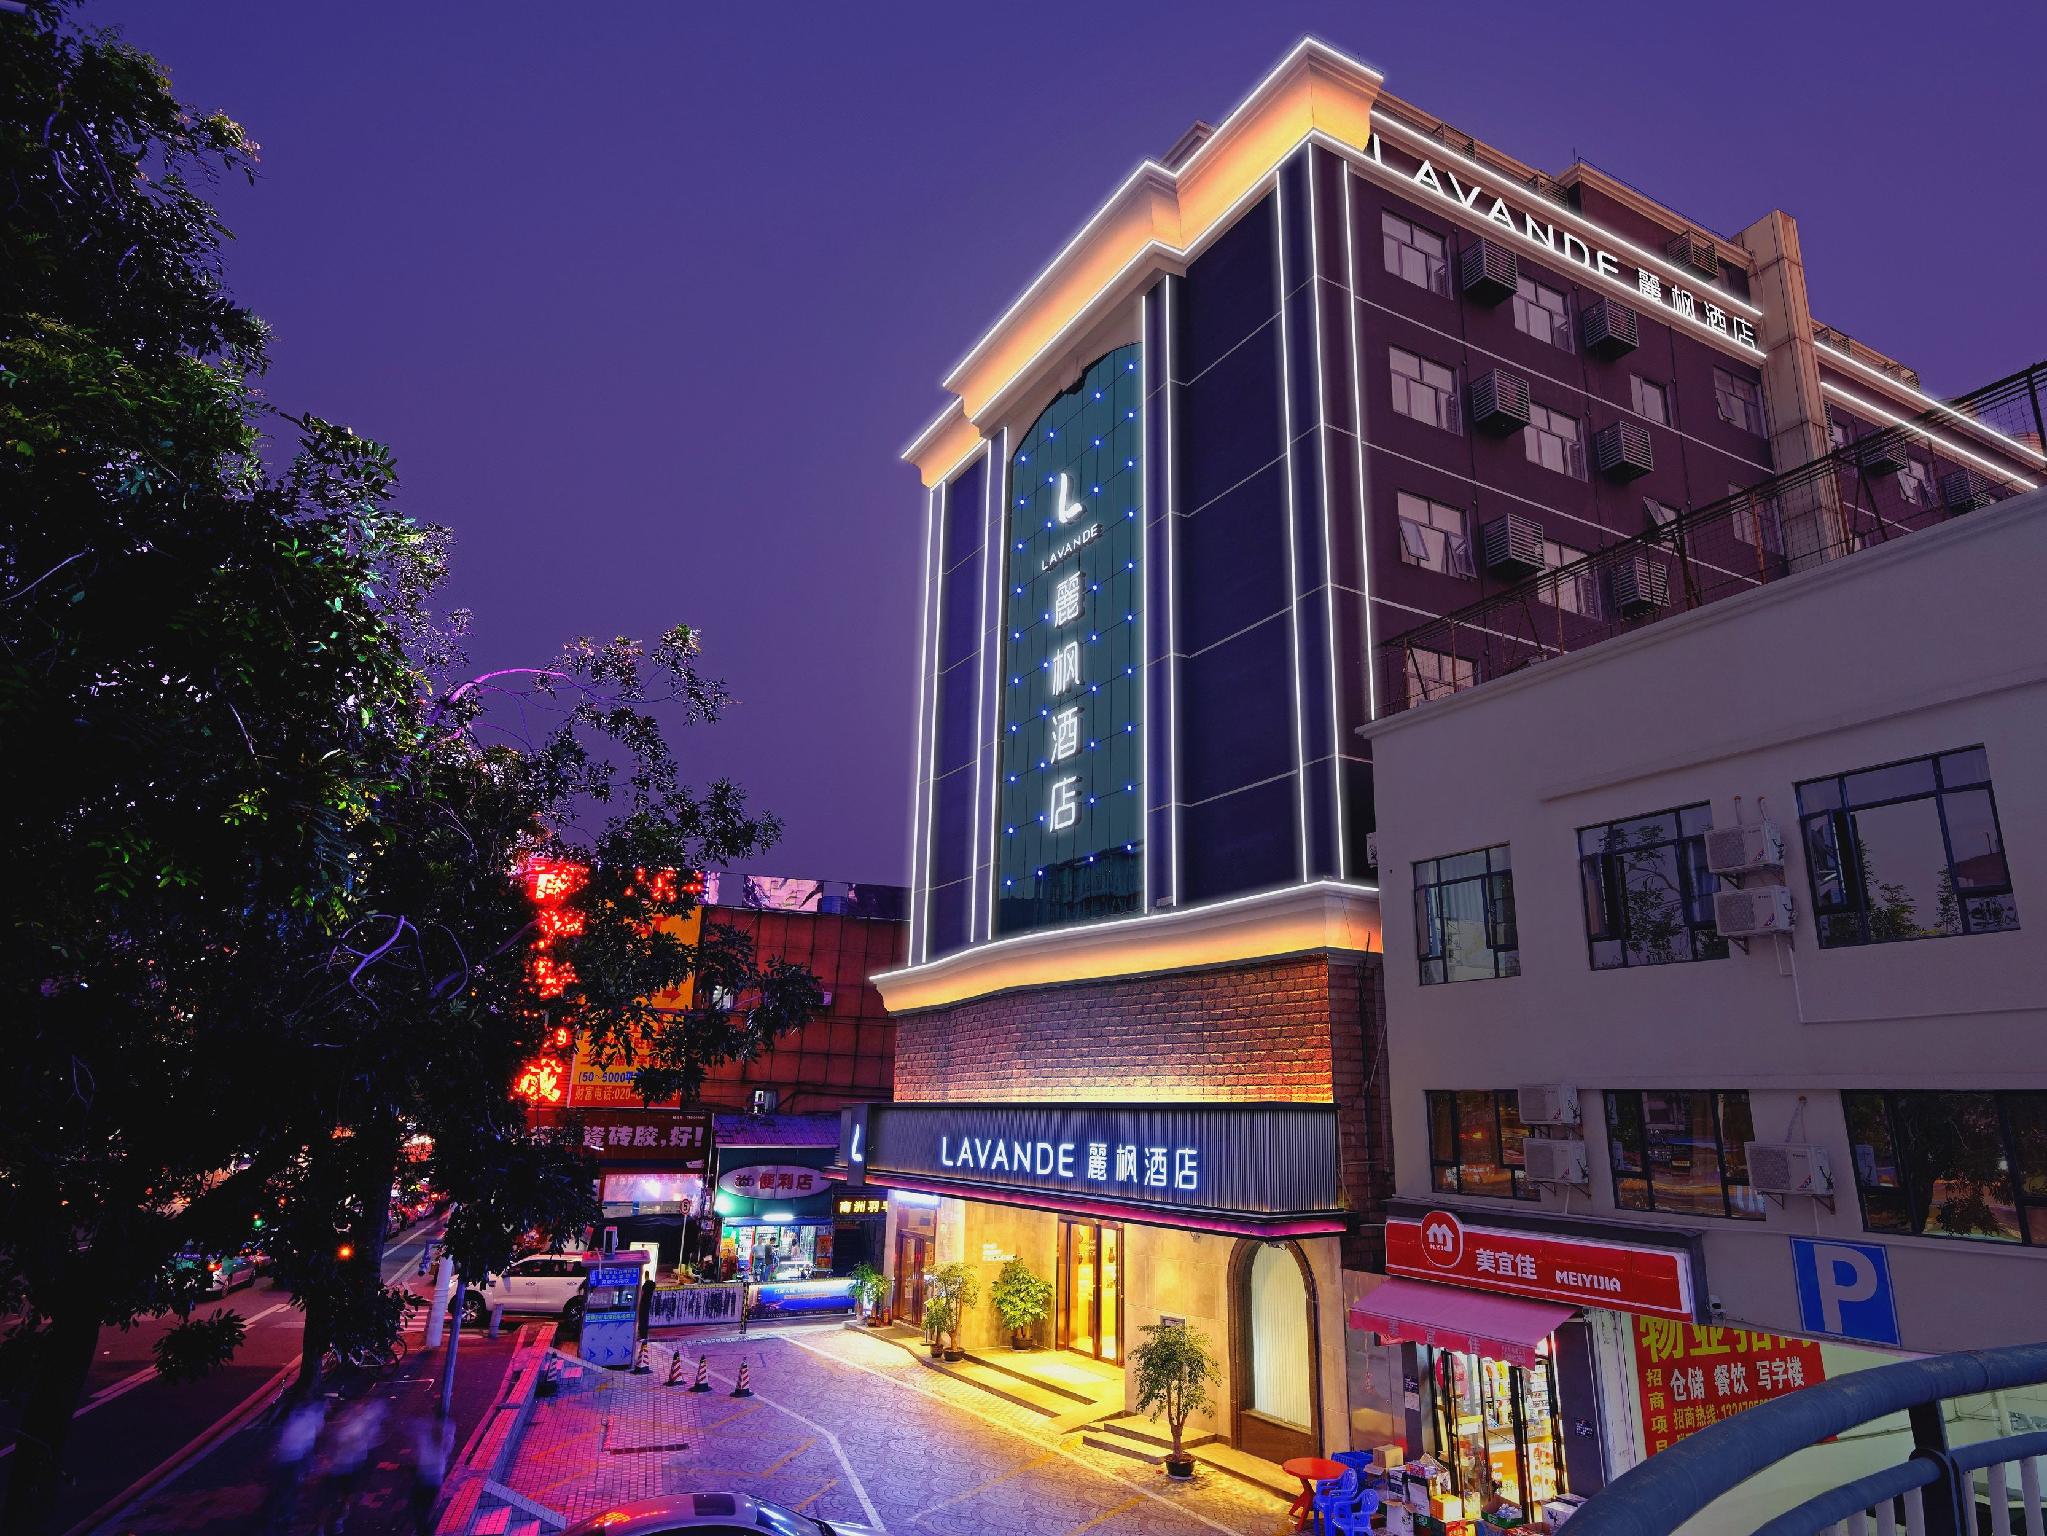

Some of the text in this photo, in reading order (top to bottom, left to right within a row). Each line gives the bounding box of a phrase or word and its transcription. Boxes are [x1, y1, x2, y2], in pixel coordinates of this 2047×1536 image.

[1373, 133, 1620, 278] LAVANDE
[1041, 524, 1099, 572] LAVANDE
[941, 1136, 1199, 1190] LAVANDE 麗枫酒店
[1475, 1247, 1621, 1292] 美宜佳 MEIYIJIA
[1813, 1243, 1878, 1334] P
[1639, 1315, 1812, 1363] 物业
[1670, 1355, 1805, 1401] 仓储 餐饮 写字楼
